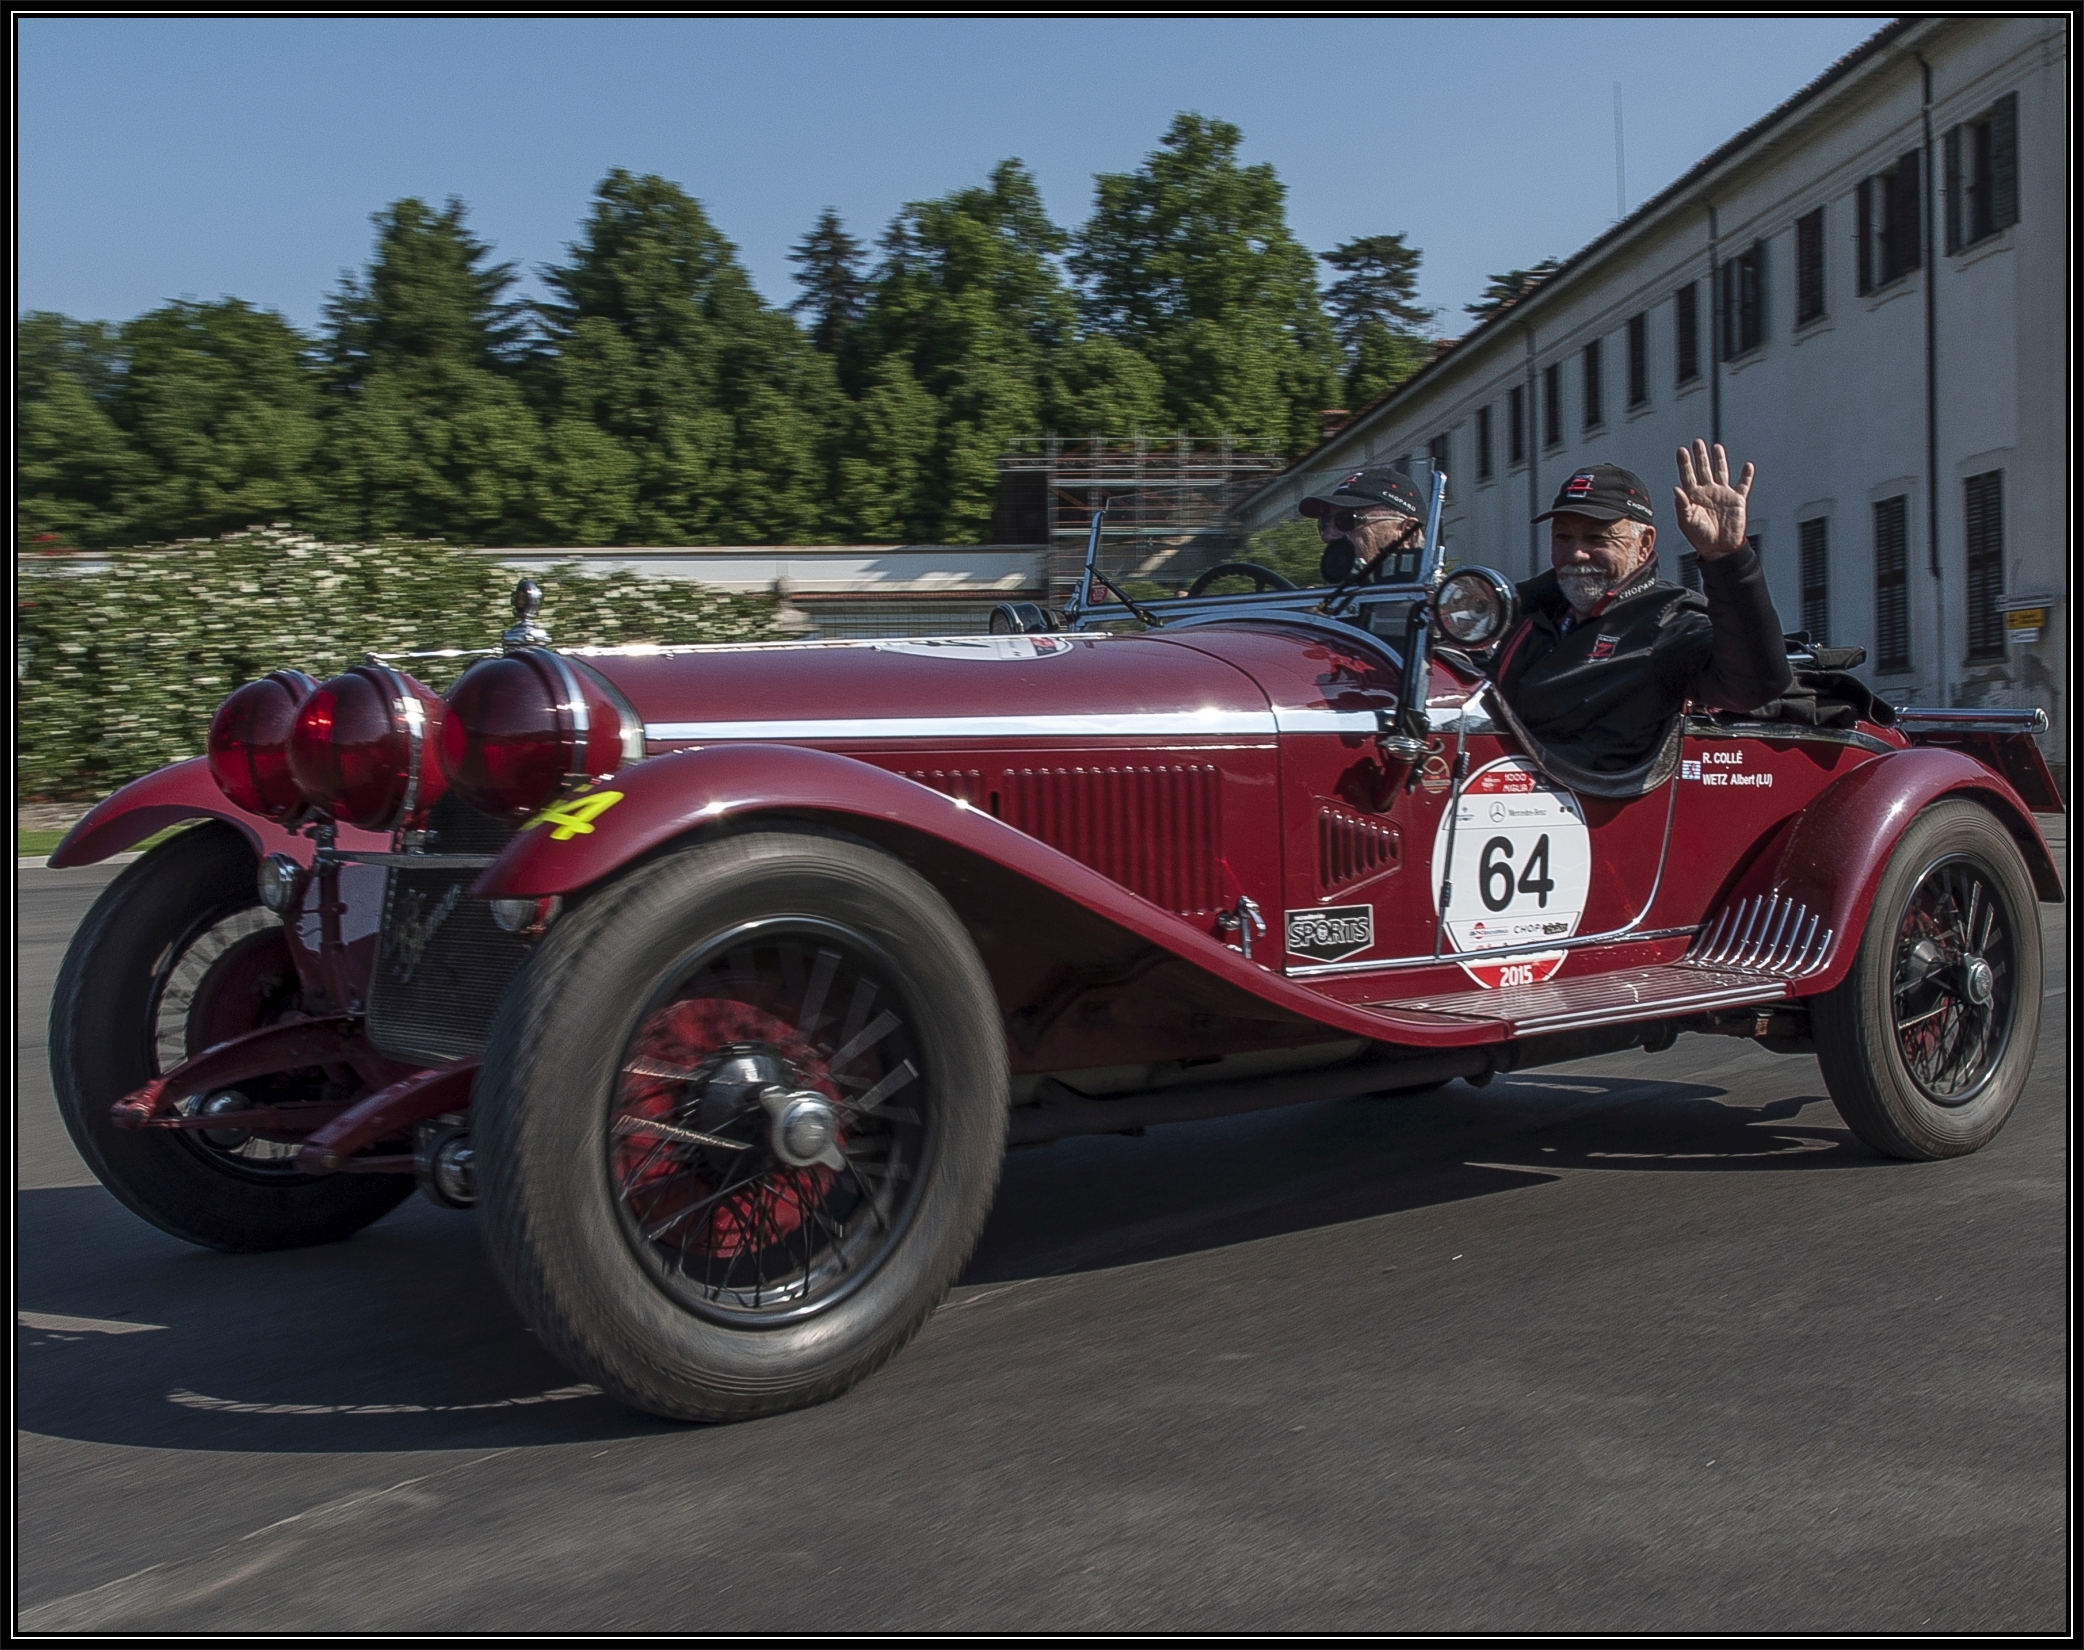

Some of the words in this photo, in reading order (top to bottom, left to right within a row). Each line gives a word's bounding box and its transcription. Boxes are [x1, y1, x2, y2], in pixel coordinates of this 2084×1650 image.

[1382, 491, 1416, 512] CHOPARD
[1702, 752, 1712, 763] R.
[1504, 773, 1527, 782] 1000
[1702, 773, 1728, 785] WETZ
[1730, 773, 1755, 785] Albert
[1480, 833, 1555, 912] 64
[1288, 916, 1370, 947] SPORTS
[1499, 965, 1534, 987] 2015
